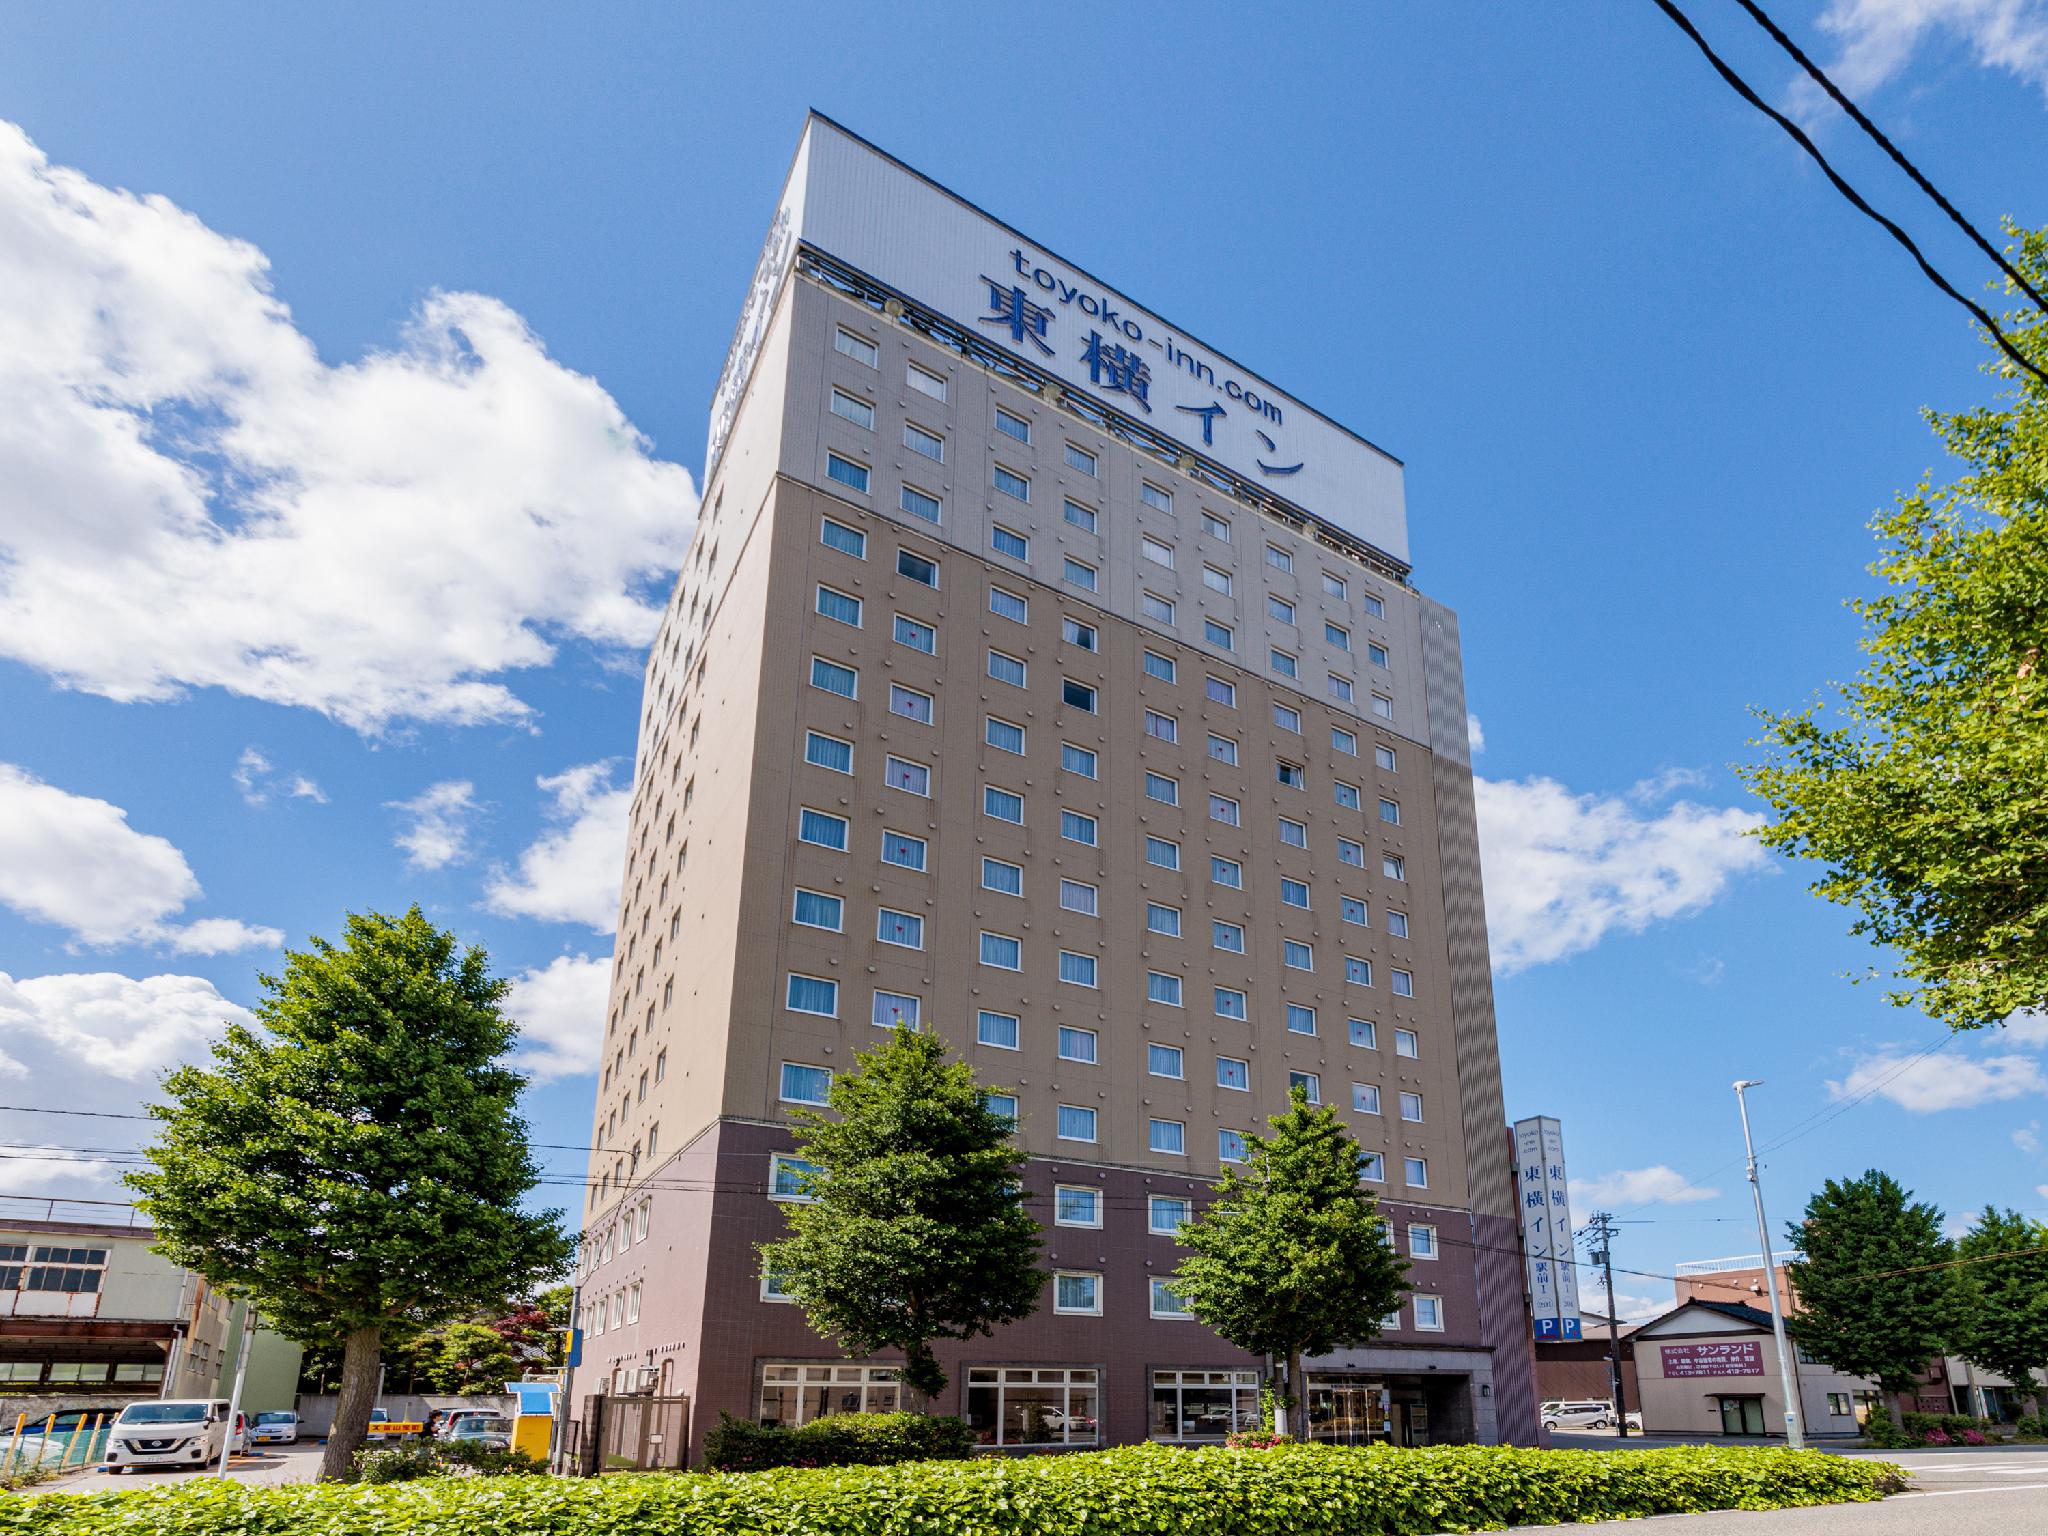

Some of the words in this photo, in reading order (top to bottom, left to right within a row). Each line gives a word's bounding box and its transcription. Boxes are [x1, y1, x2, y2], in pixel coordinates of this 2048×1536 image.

[1010, 249, 1282, 425] toyoko-inn.com
[979, 274, 1304, 475] 東横イン
[1541, 1319, 1553, 1334] P
[1565, 1318, 1575, 1334] P
[1696, 1343, 1754, 1356] サンランド
